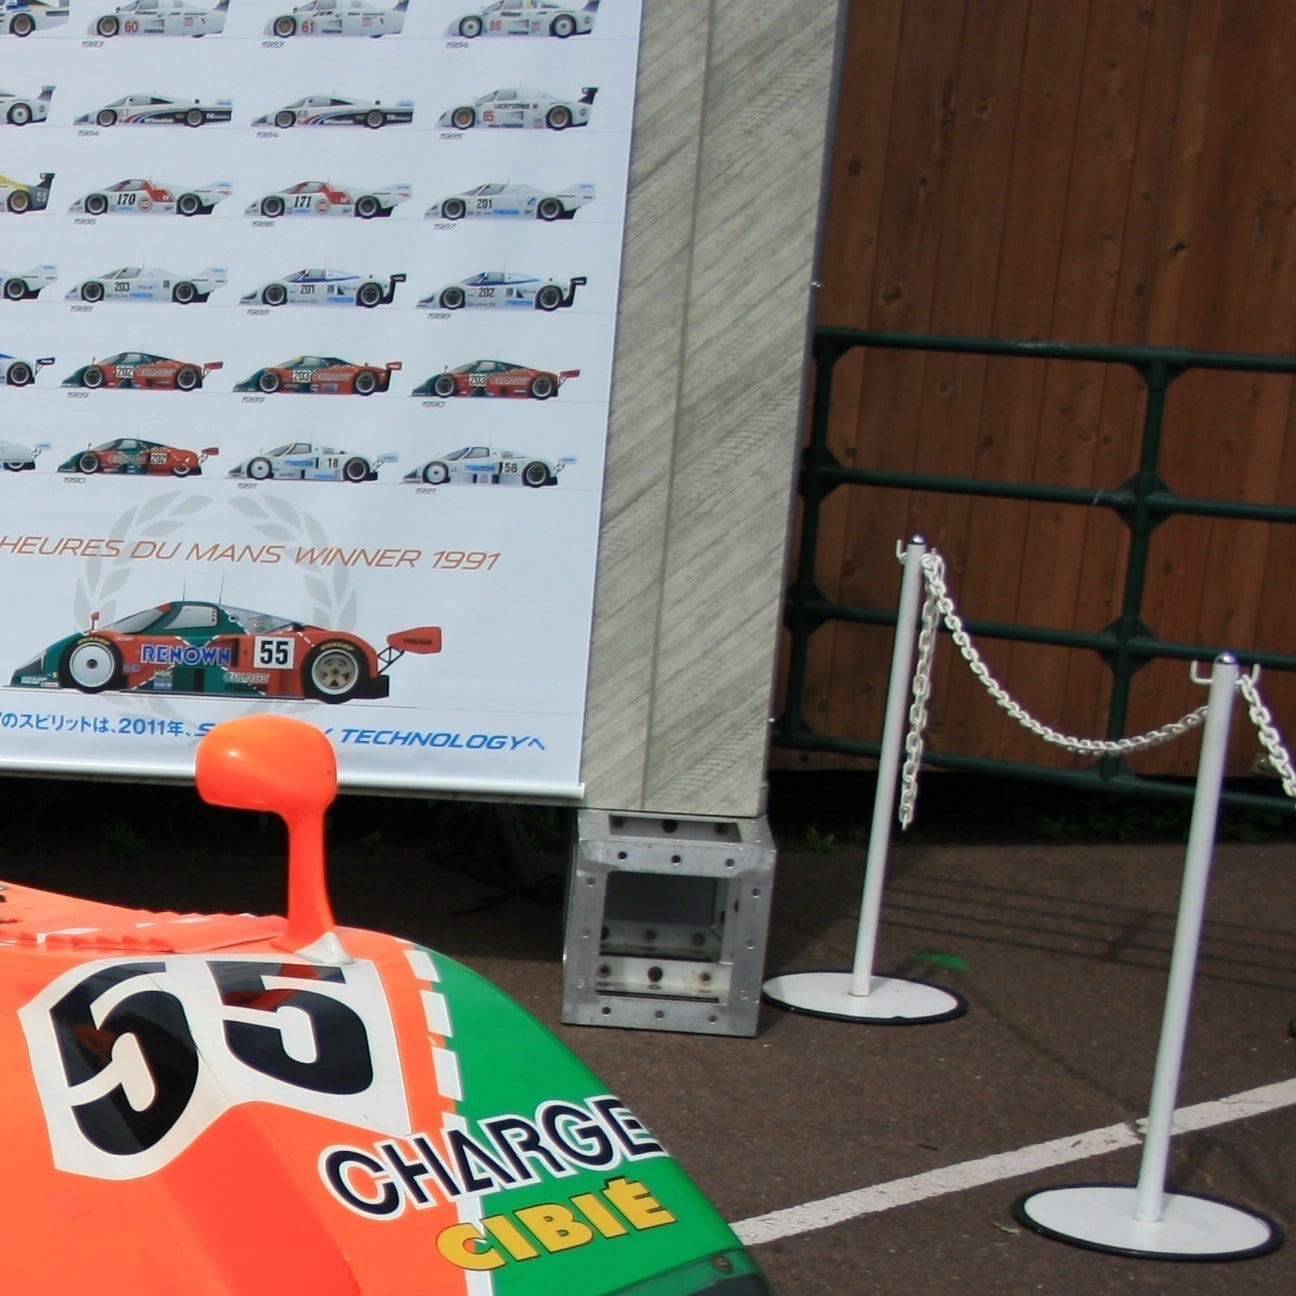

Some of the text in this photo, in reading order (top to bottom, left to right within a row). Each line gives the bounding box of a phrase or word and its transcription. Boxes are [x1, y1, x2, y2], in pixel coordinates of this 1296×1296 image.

[124, 20, 138, 32] 60
[301, 21, 314, 33] 61
[116, 193, 136, 205] 170
[294, 196, 311, 207] 171
[477, 199, 492, 209] 201
[114, 282, 130, 291] 203
[300, 284, 314, 294] 201
[478, 288, 495, 297] 202
[116, 366, 133, 378] 202
[293, 370, 310, 382] 203
[471, 374, 486, 385] 203
[151, 453, 167, 464] 202
[328, 457, 339, 468] 18
[503, 463, 517, 473] 56
[130, 540, 182, 559] DU
[185, 543, 285, 564] MANS
[294, 548, 421, 568] WINNER
[432, 550, 501, 571] 1991
[140, 643, 232, 666] RENOWN
[259, 640, 288, 664] 55
[49, 960, 374, 1155] 55
[318, 1095, 671, 1221] CHARGE
